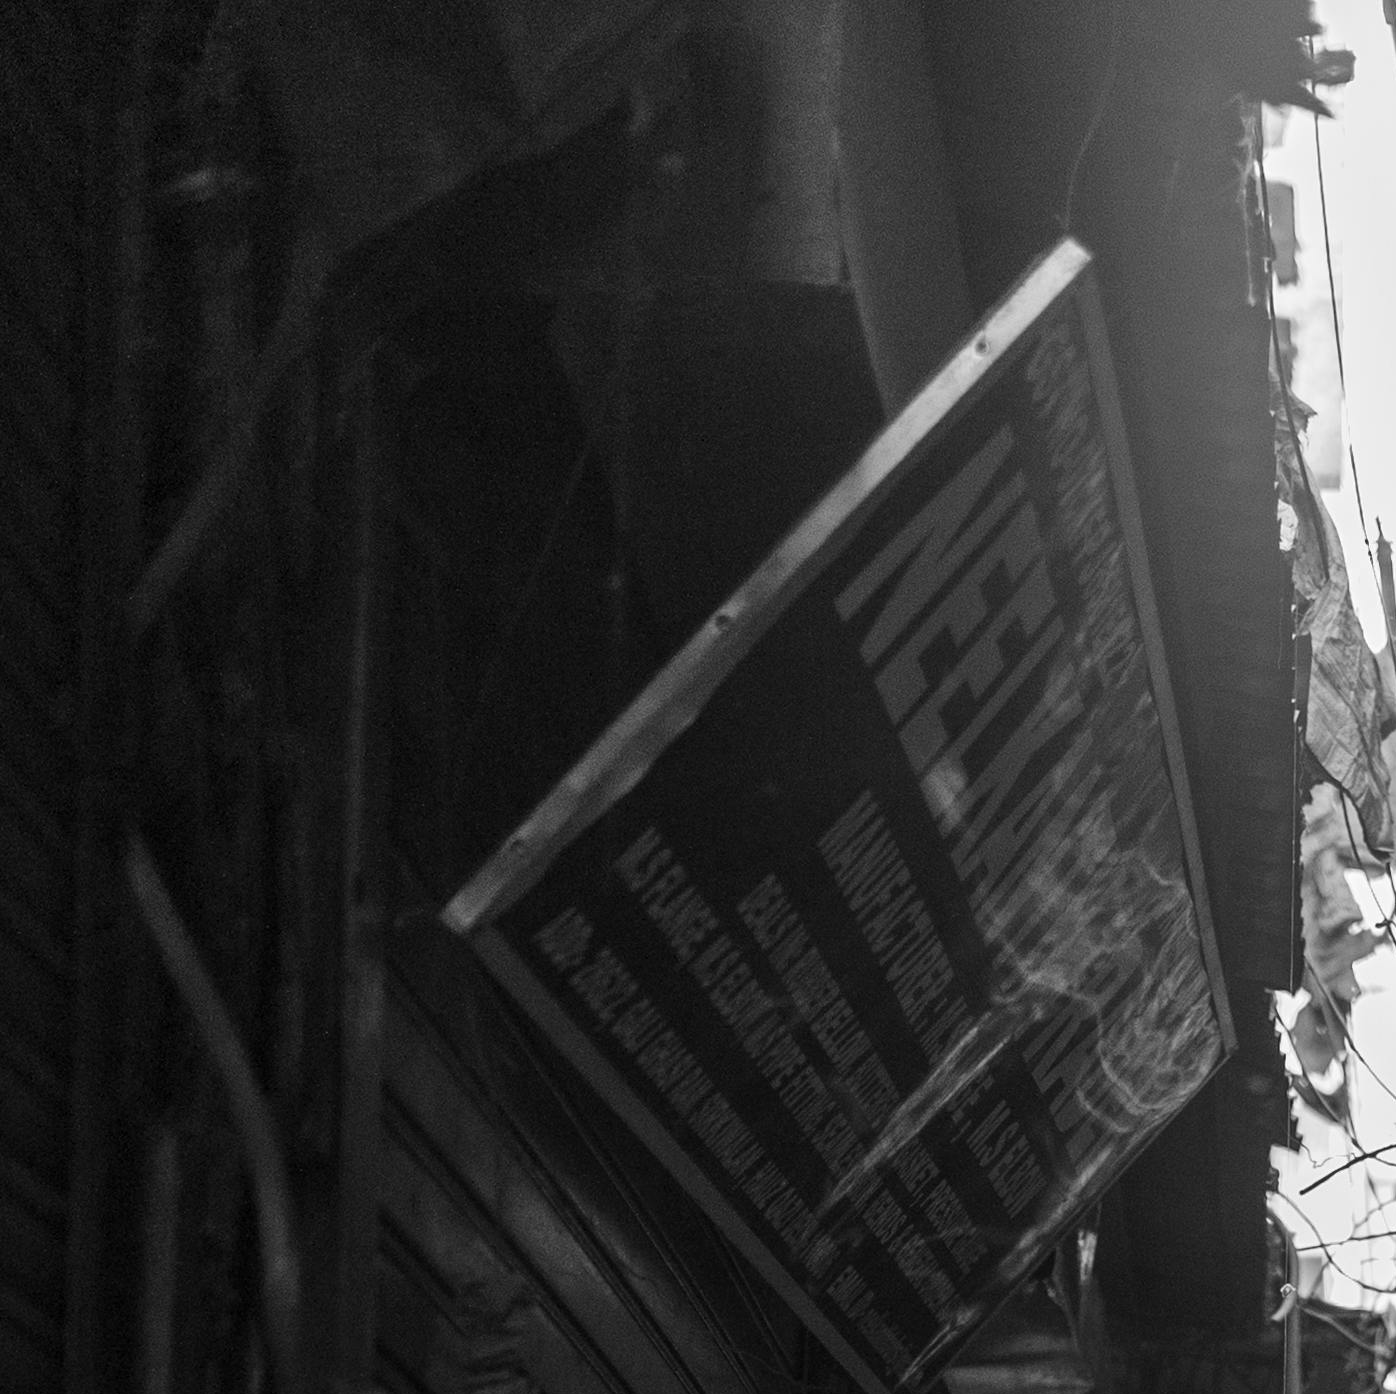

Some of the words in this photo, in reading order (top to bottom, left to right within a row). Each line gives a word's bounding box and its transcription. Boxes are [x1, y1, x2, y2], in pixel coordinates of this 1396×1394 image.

[734, 869, 799, 954] DEALS
[754, 1029, 807, 1093] PIPE
[860, 1186, 908, 1247] BENDS
[986, 1134, 1046, 1221] ELBOW
